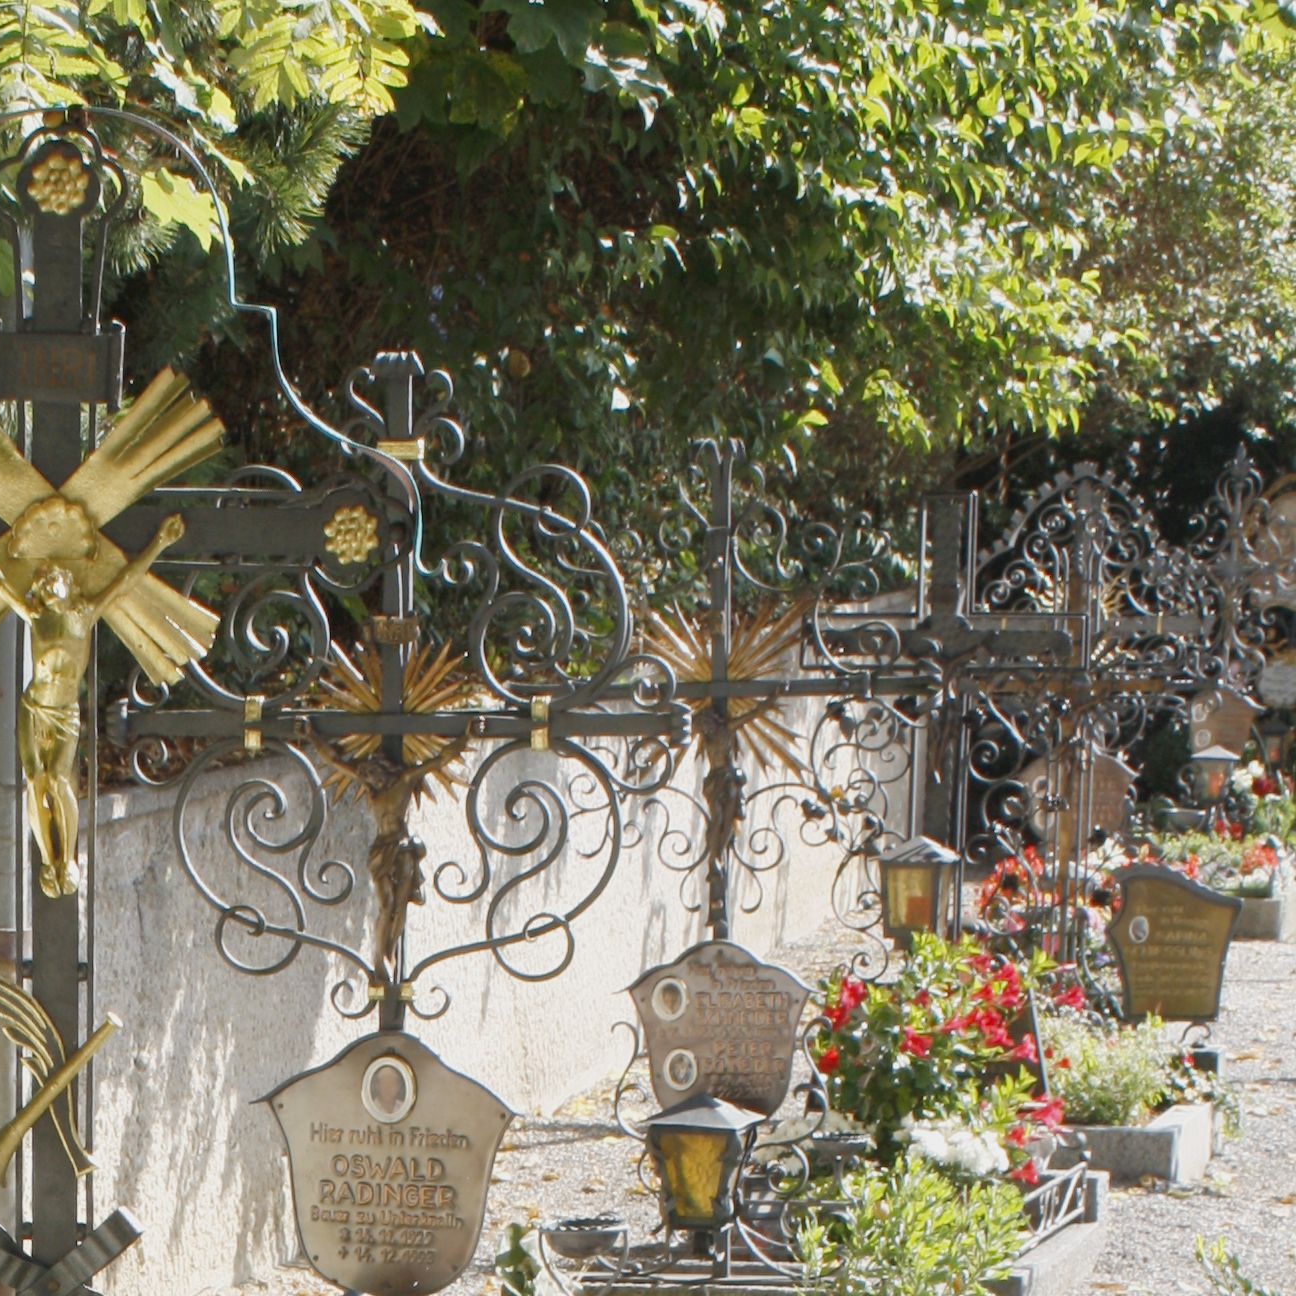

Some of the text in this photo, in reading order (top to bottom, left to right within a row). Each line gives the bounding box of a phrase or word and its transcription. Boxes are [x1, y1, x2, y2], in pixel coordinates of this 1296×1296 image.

[21, 347, 96, 385] INRI
[310, 1122, 470, 1150] Hier ruht in Frieden
[331, 1154, 445, 1182] OSWALD
[319, 1180, 458, 1210] RADINGER
[310, 1205, 350, 1223] Bauer
